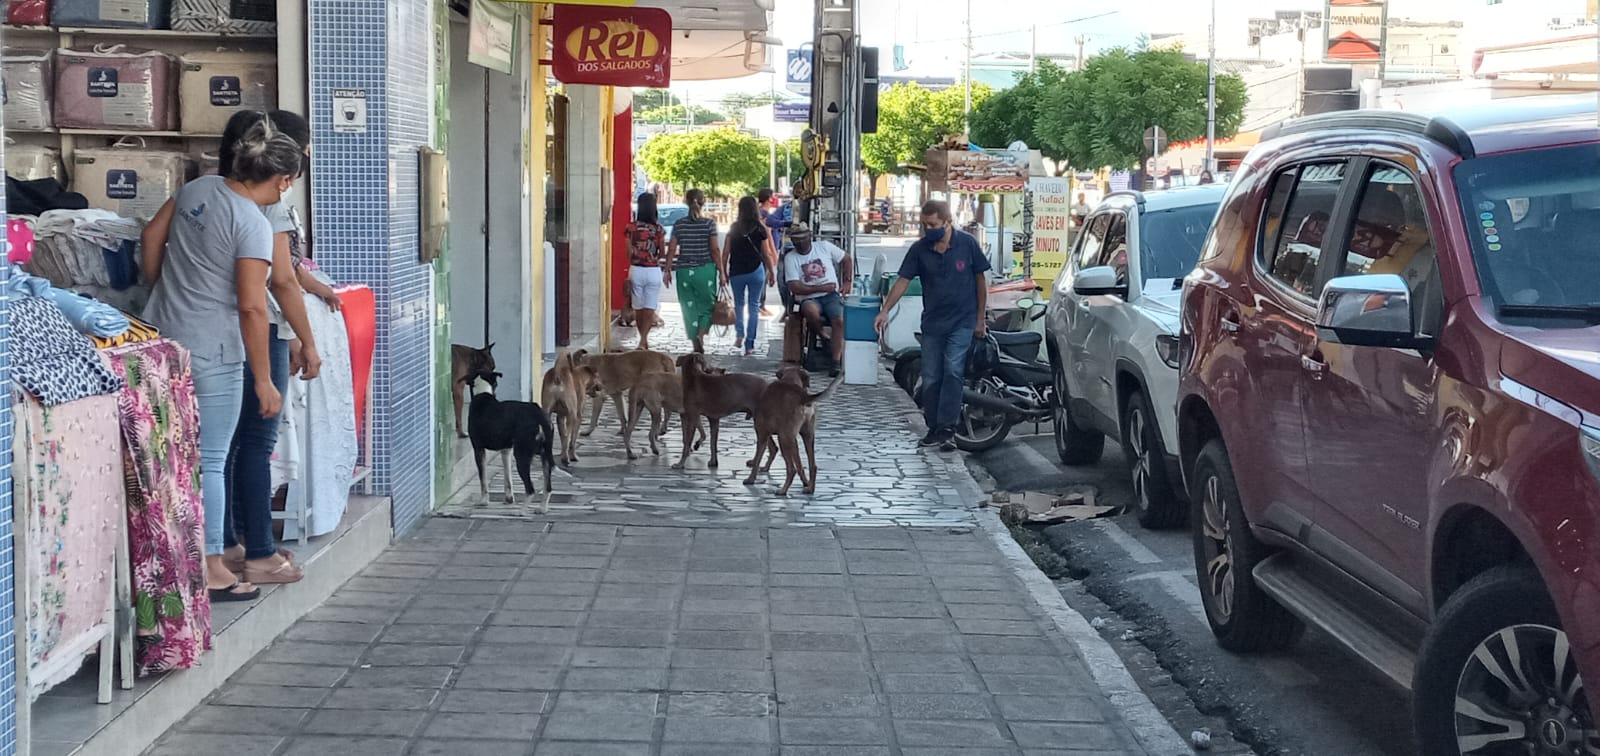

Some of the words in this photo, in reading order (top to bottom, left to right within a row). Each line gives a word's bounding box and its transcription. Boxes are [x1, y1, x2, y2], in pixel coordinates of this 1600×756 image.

[578, 23, 646, 61] Rei
[578, 62, 599, 72] DOS
[600, 60, 651, 71] SALGADOS
[335, 89, 366, 98] ATENÇÃO
[1035, 237, 1060, 252] MINUTO
